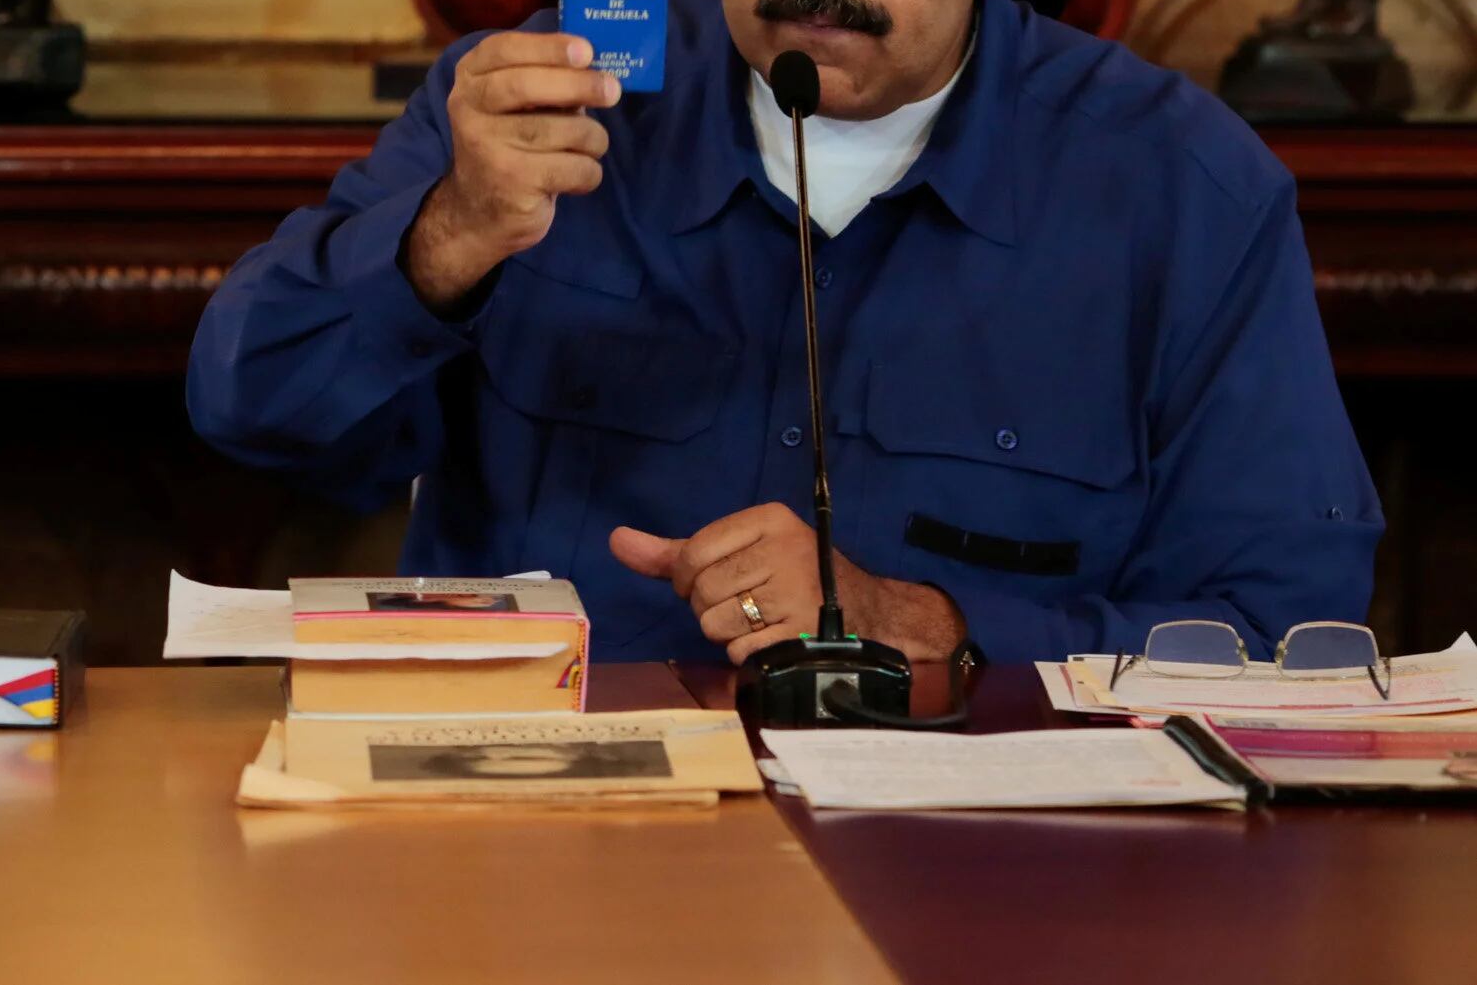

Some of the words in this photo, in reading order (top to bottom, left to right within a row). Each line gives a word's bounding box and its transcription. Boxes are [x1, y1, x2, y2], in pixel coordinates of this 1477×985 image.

[609, 0, 625, 8] DE
[584, 8, 649, 20] VENEZUELA
[600, 52, 617, 60] CON
[619, 52, 631, 60] LA
